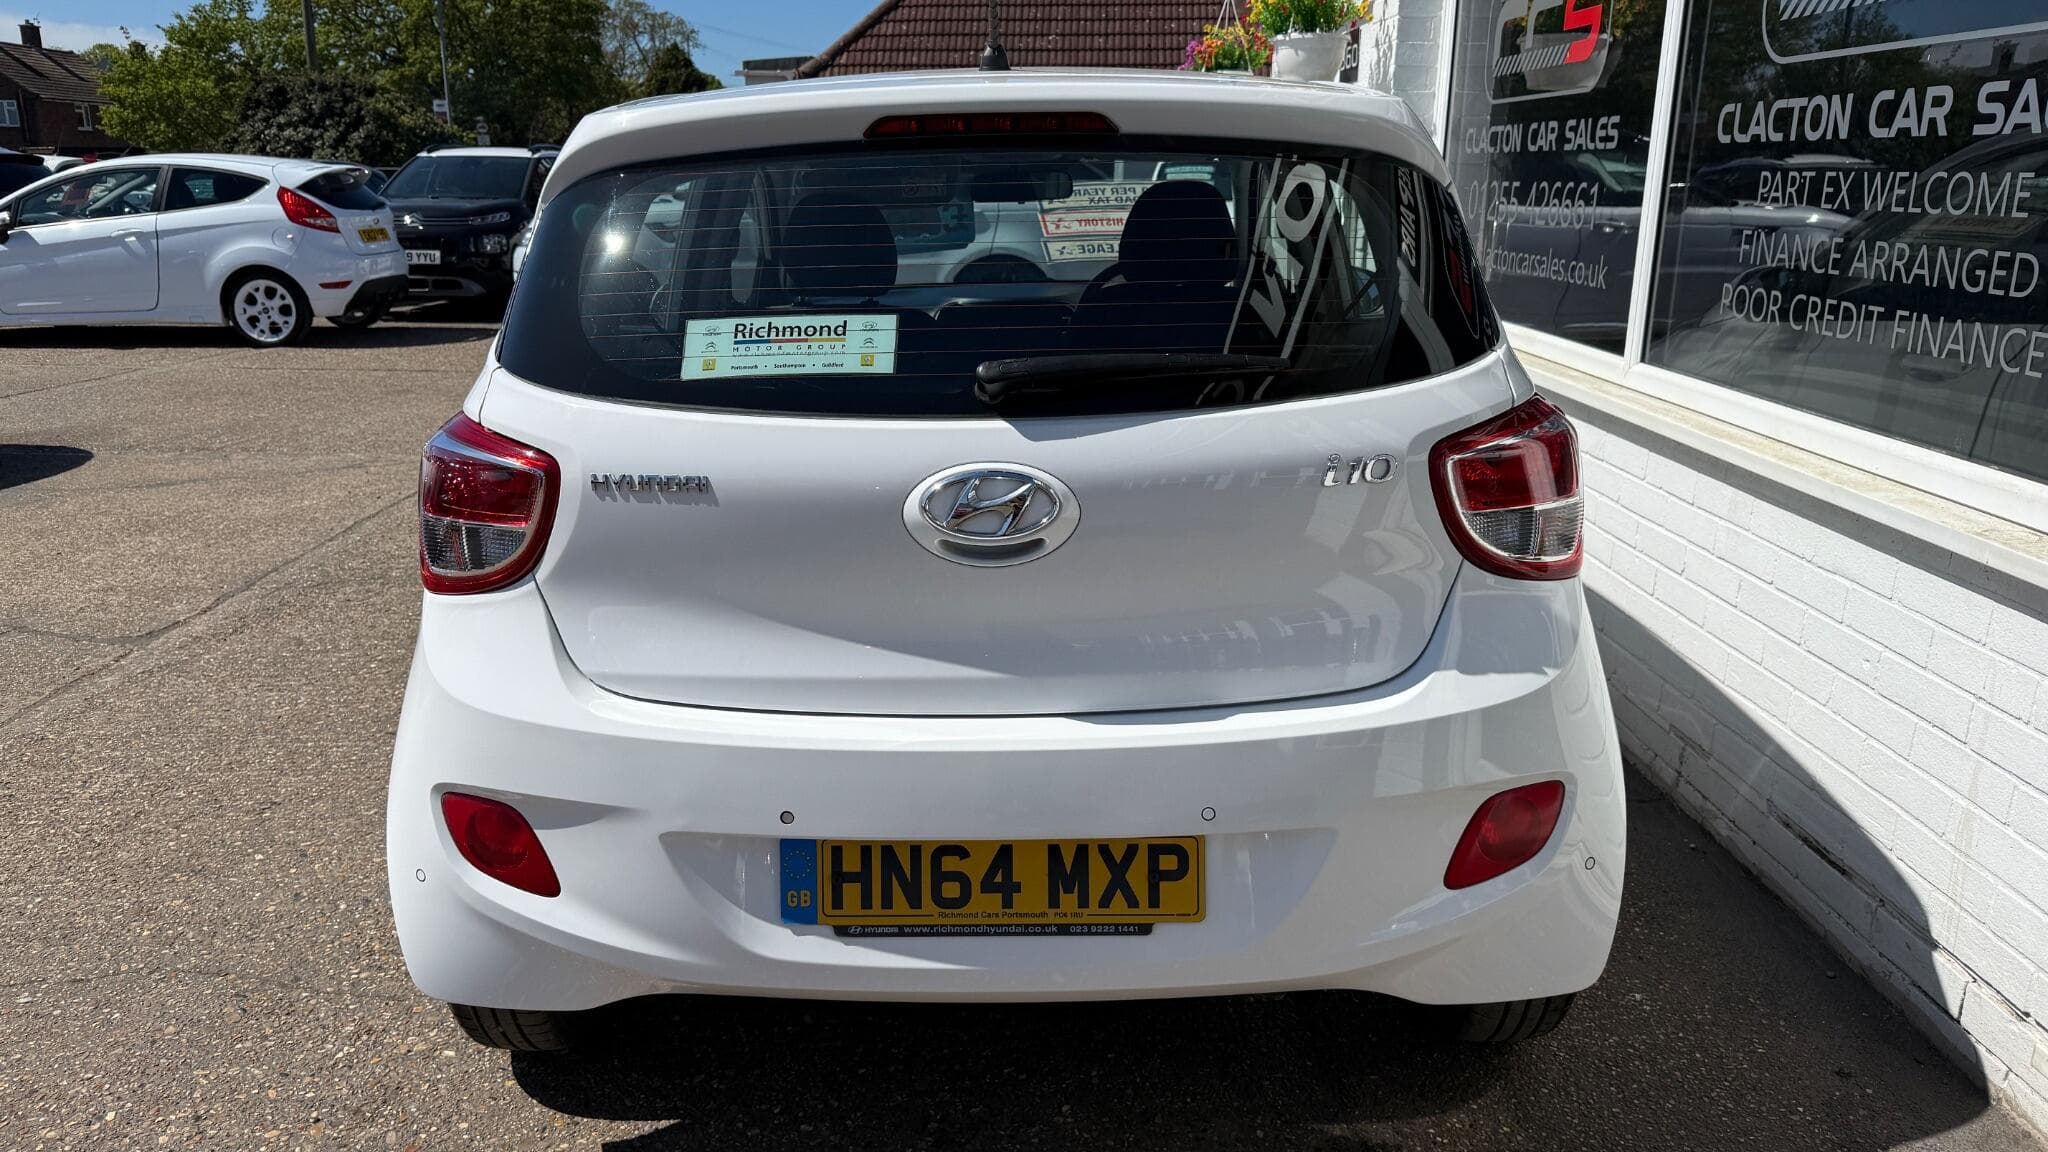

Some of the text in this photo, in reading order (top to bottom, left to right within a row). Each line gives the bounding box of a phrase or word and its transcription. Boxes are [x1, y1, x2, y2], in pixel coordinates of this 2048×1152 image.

[1717, 77, 2048, 144] CLACTON CAR SA
[1464, 115, 1621, 154] CLACTON CAR SALES
[1468, 180, 1600, 231] 01255 426661
[1756, 171, 2036, 219] PART EX WELCOME
[1479, 245, 1609, 290] lactoncarsales.co.uk
[1738, 229, 2040, 298] FINANCE ARRANGED
[732, 345, 783, 353] MOTOR
[795, 343, 847, 351] GROUP
[733, 319, 848, 340] Richmond
[1720, 282, 2048, 379] POOR CREDIT FINANCE
[589, 472, 712, 494] HYUNDAI
[1320, 453, 1398, 487] i10
[830, 843, 1190, 911] HN64 MXP
[786, 889, 812, 908] GB
[938, 911, 979, 919] Richmond
[980, 911, 1000, 919] Cars
[1001, 911, 1049, 919] Portsmouth
[903, 924, 1058, 935] www.richmondhyundai.co.uk
[1069, 925, 1088, 933] 023
[1091, 925, 1115, 933] 9222
[1118, 925, 1139, 933] 1441
